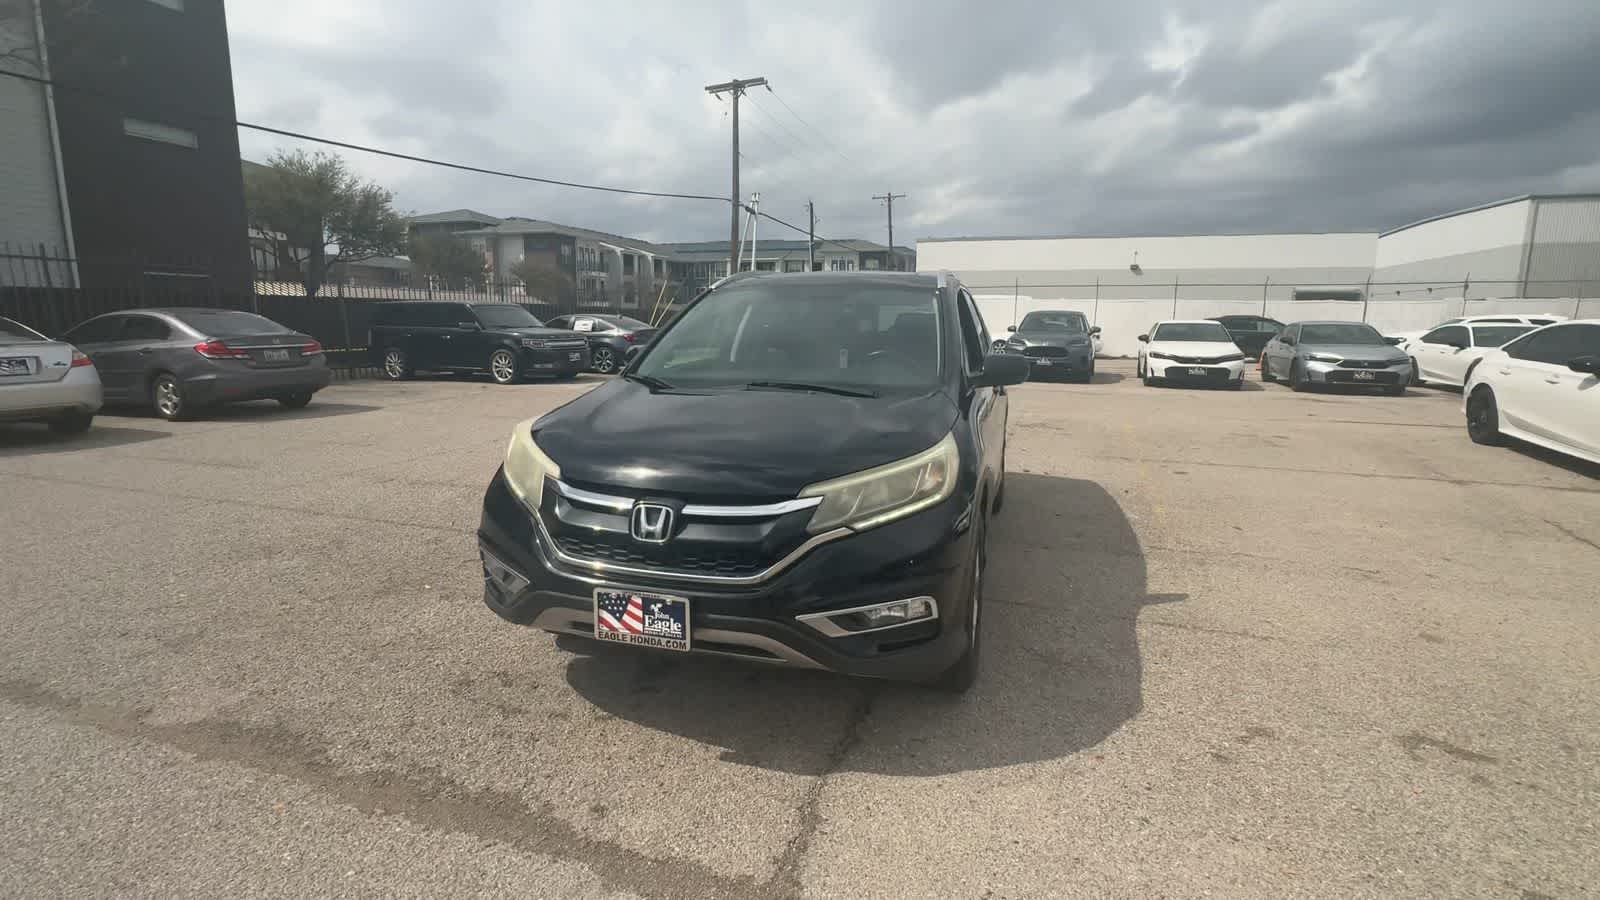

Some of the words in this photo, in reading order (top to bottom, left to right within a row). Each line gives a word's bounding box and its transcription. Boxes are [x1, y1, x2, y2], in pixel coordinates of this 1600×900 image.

[644, 614, 682, 633] Eagle
[655, 611, 670, 620] John
[598, 631, 629, 642] EAGLE
[630, 635, 687, 650] HONDA.COM
